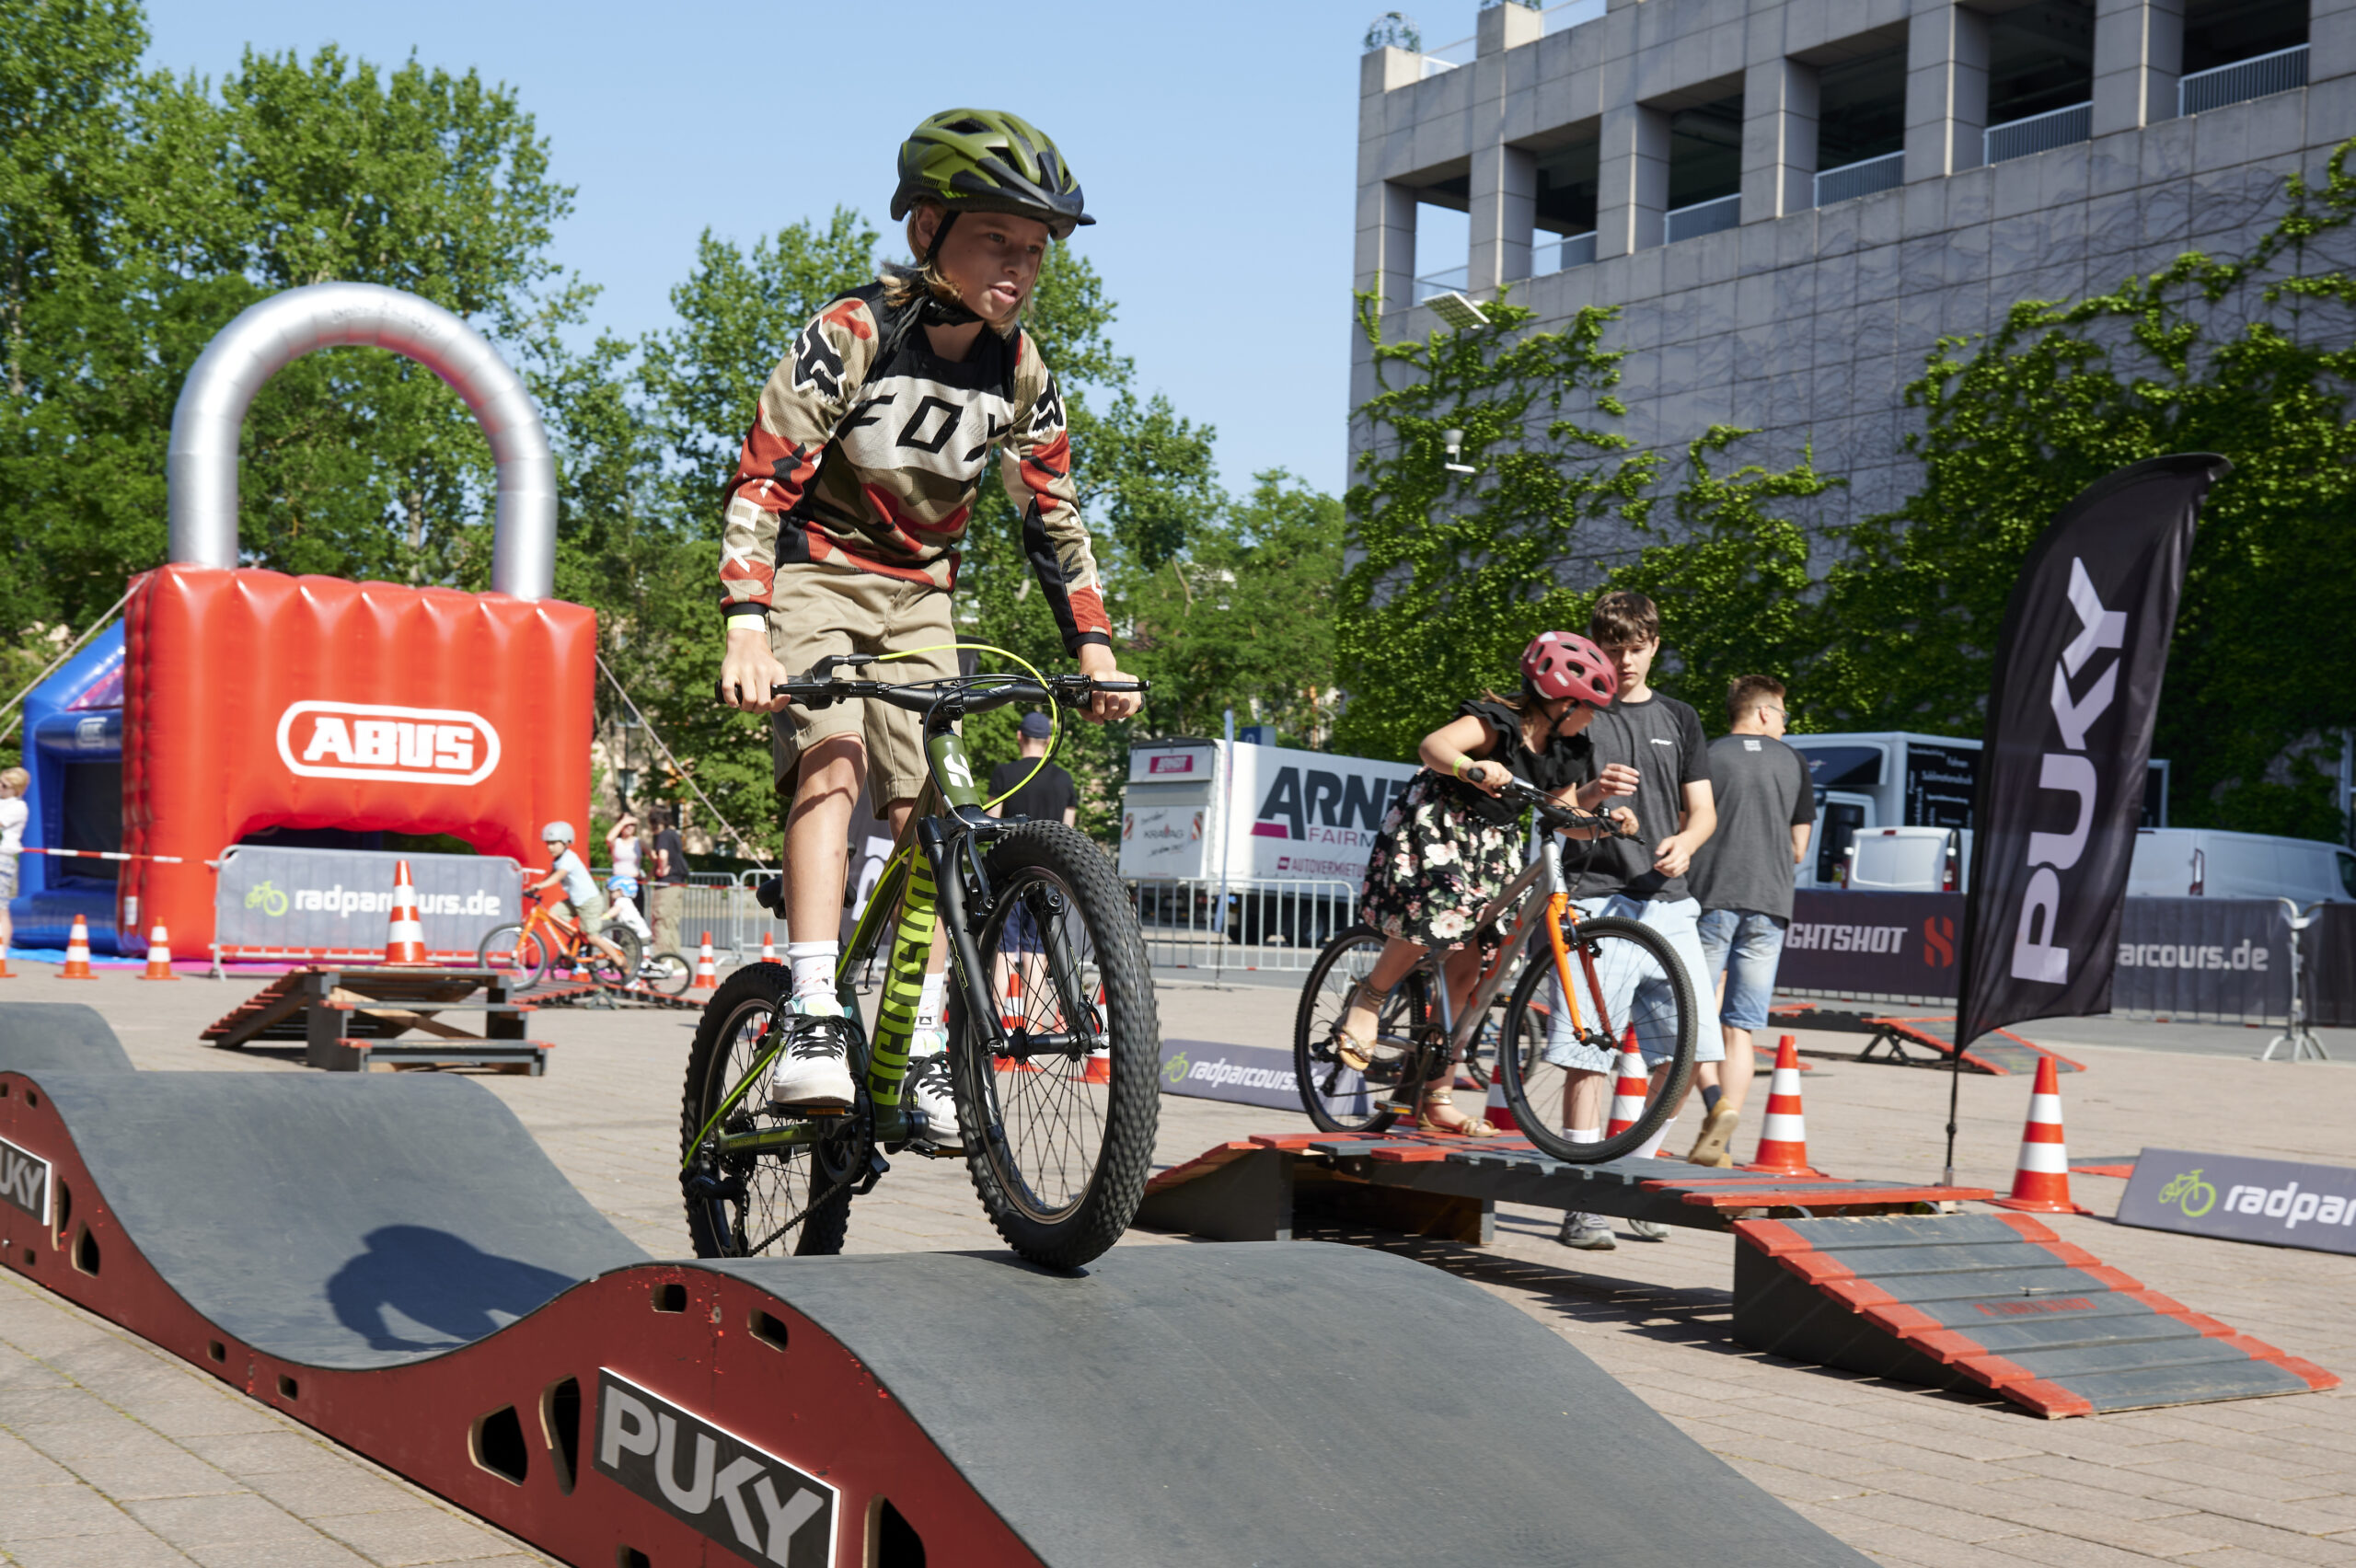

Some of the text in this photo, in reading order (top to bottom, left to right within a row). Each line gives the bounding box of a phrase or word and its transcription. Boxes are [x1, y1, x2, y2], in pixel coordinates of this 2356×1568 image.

[303, 717, 475, 770] ABUS
[2011, 556, 2128, 985] PUKY
[294, 884, 501, 917] radparurs.de
[2118, 939, 2269, 972] arcours.de
[1188, 1058, 1325, 1092] radparcours.e
[600, 1384, 825, 1568] PUKY
